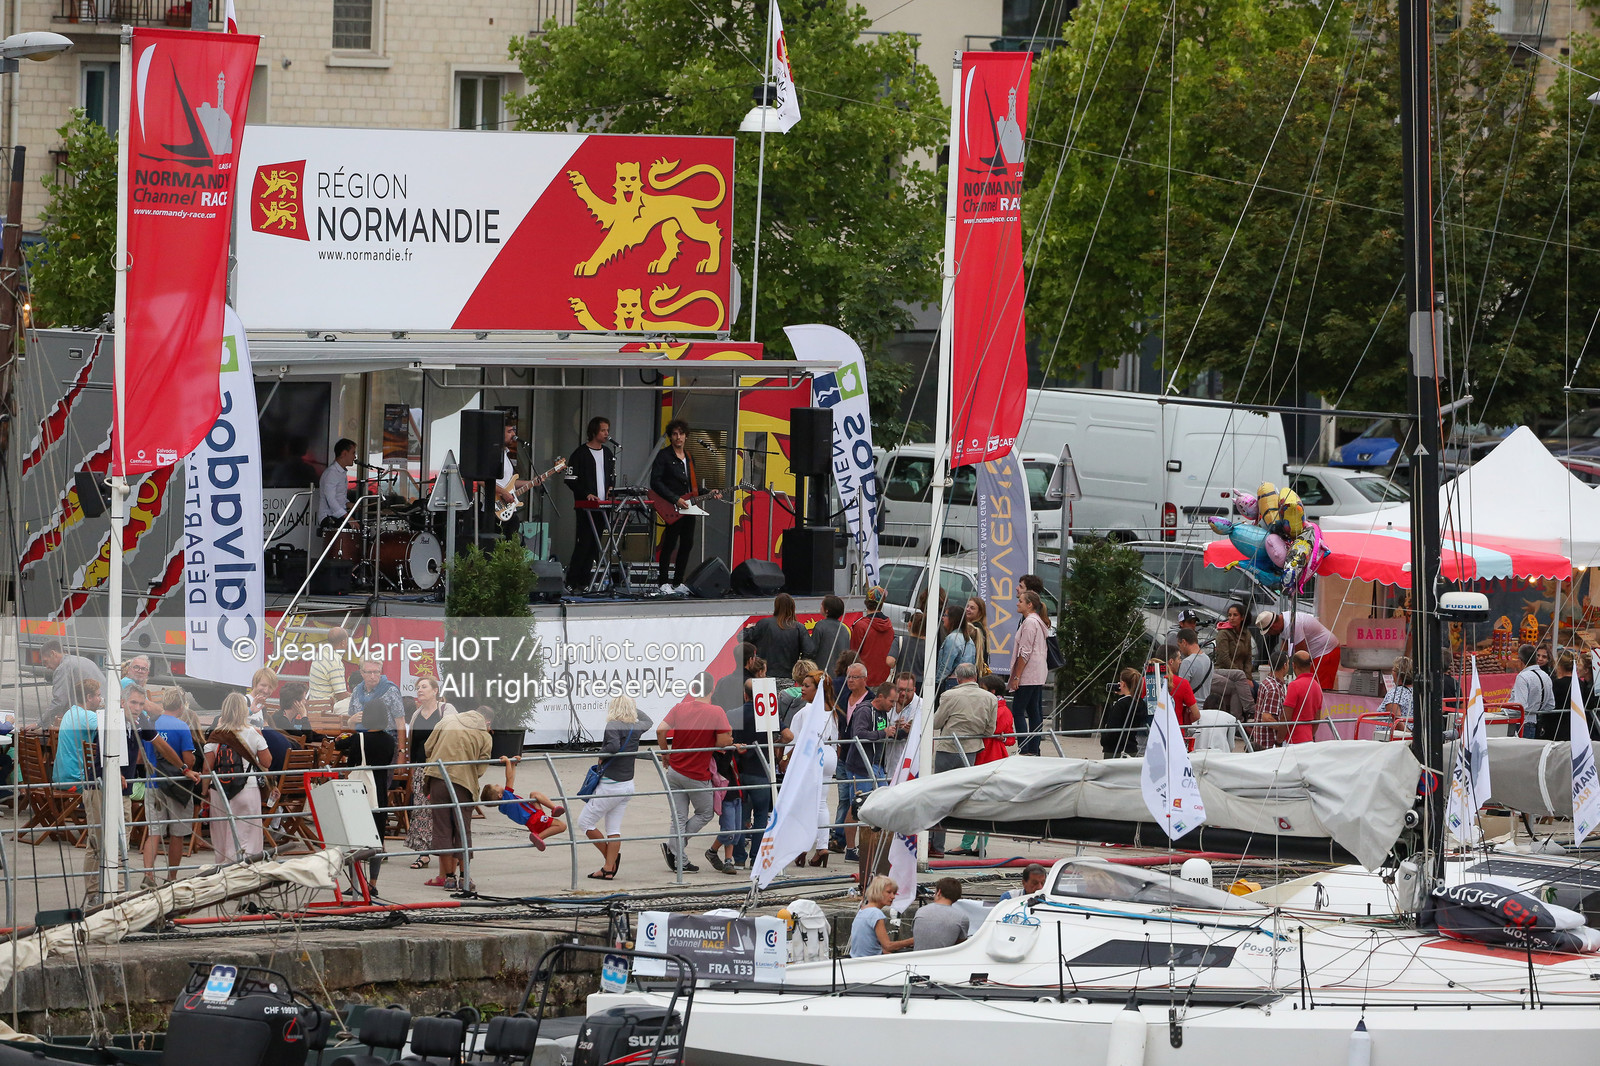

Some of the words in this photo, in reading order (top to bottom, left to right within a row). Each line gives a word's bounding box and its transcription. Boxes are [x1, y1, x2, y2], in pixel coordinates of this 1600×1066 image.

[135, 169, 231, 189] NORMANDY
[318, 165, 407, 199] RÉGION
[133, 187, 197, 205] Channel
[200, 191, 228, 207] RACE
[963, 198, 998, 213] Channel
[1000, 197, 1021, 211] RA
[133, 208, 216, 219] www.normandy-race.com
[317, 206, 500, 244] NORMANDIE
[318, 248, 413, 262] www.normandie.fr
[754, 692, 778, 717] 69
[669, 927, 725, 940] NORMANDY
[669, 938, 701, 948] Channel
[702, 940, 725, 949] RACE
[708, 963, 731, 975] FRA
[733, 965, 753, 976] 133
[264, 1006, 279, 1015] CHF
[578, 1041, 594, 1050] 250
